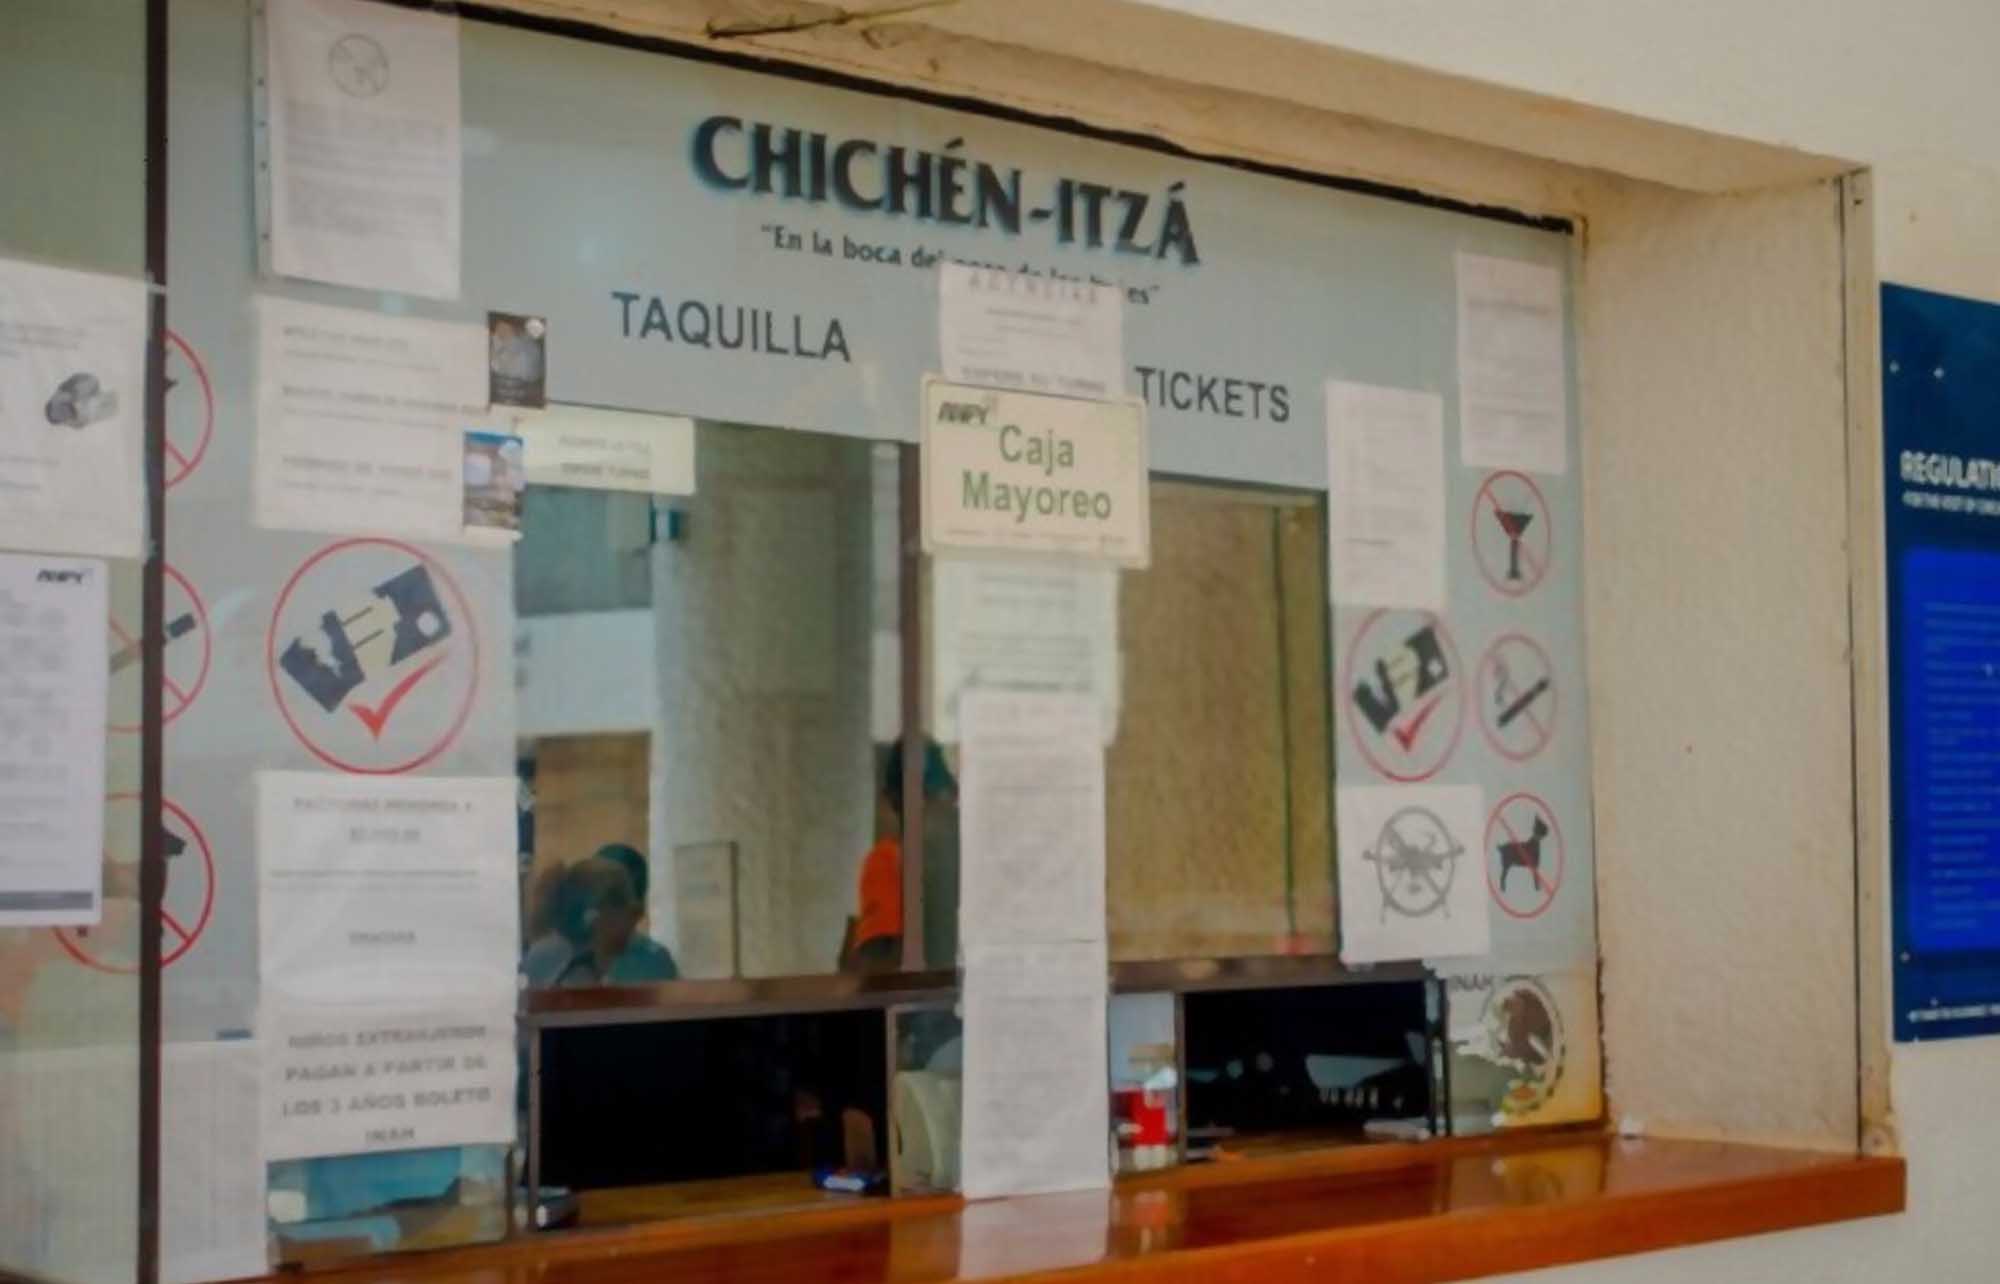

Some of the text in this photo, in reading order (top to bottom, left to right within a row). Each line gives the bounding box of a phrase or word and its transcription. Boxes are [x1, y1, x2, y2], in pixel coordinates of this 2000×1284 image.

[691, 115, 1199, 266] CHICHÉN-ITZÁ
[812, 230, 832, 255] la
[843, 235, 902, 265] boca
[611, 290, 850, 363] TAQUILLA
[1134, 366, 1290, 423] TICKETS
[998, 424, 1074, 475] Caja
[961, 469, 1112, 523] Mayoreo
[284, 1061, 358, 1082] PAGAN
[383, 1055, 456, 1077] PARTIR
